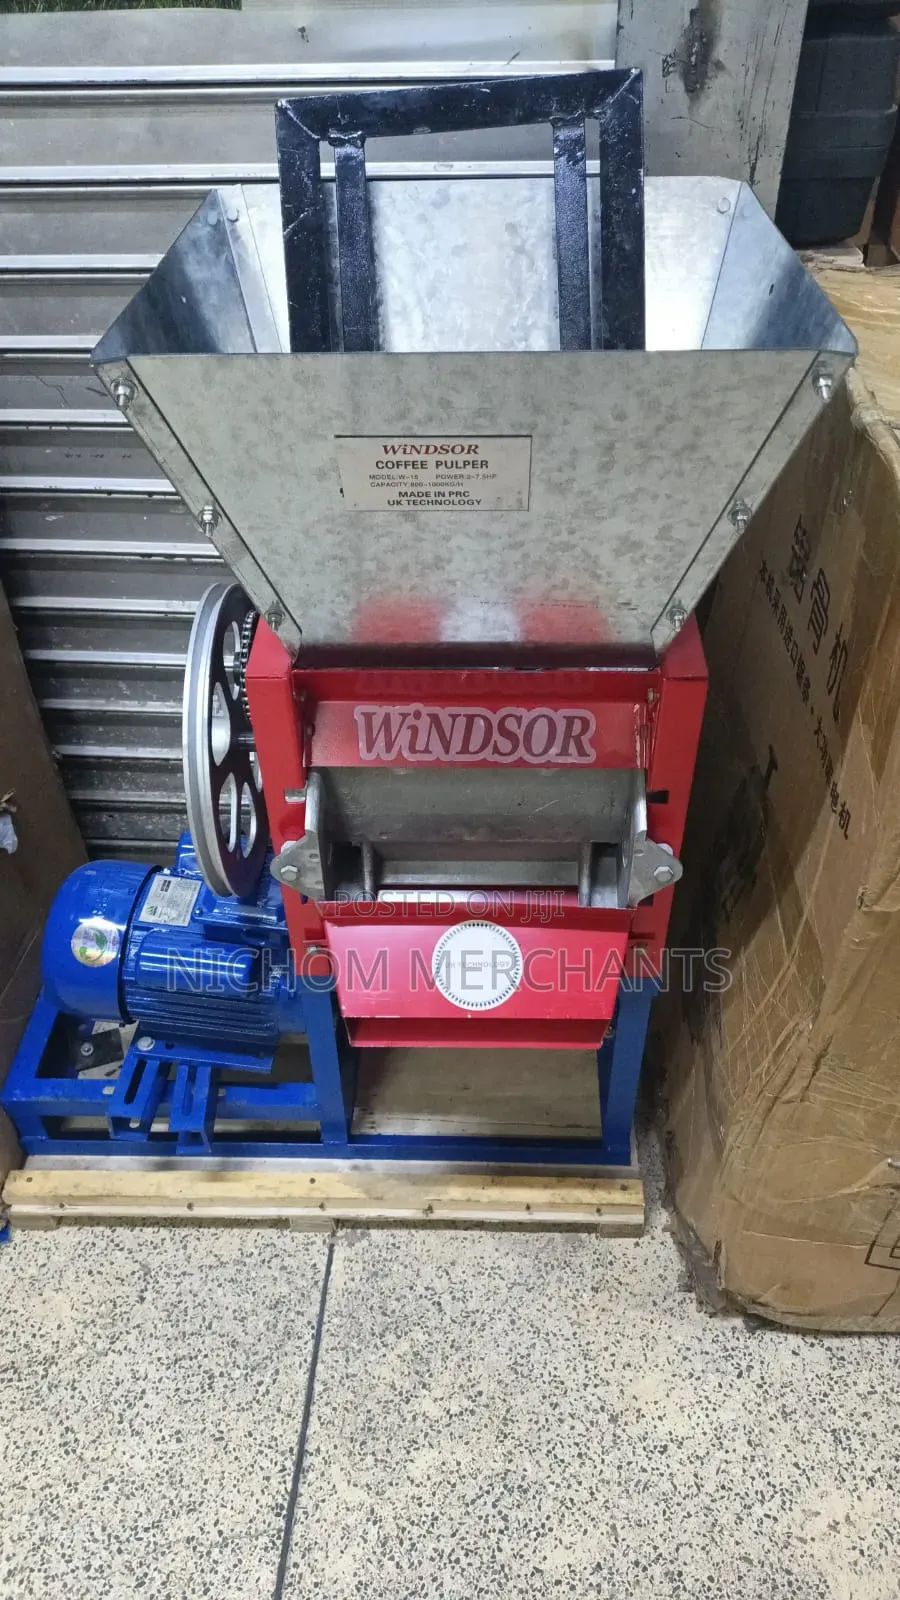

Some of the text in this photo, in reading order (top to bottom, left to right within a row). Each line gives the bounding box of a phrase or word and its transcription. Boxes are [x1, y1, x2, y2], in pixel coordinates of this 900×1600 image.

[375, 459, 489, 470] COFFEE PULPER
[398, 490, 470, 498] MADE IN PRC
[387, 499, 404, 507] UK
